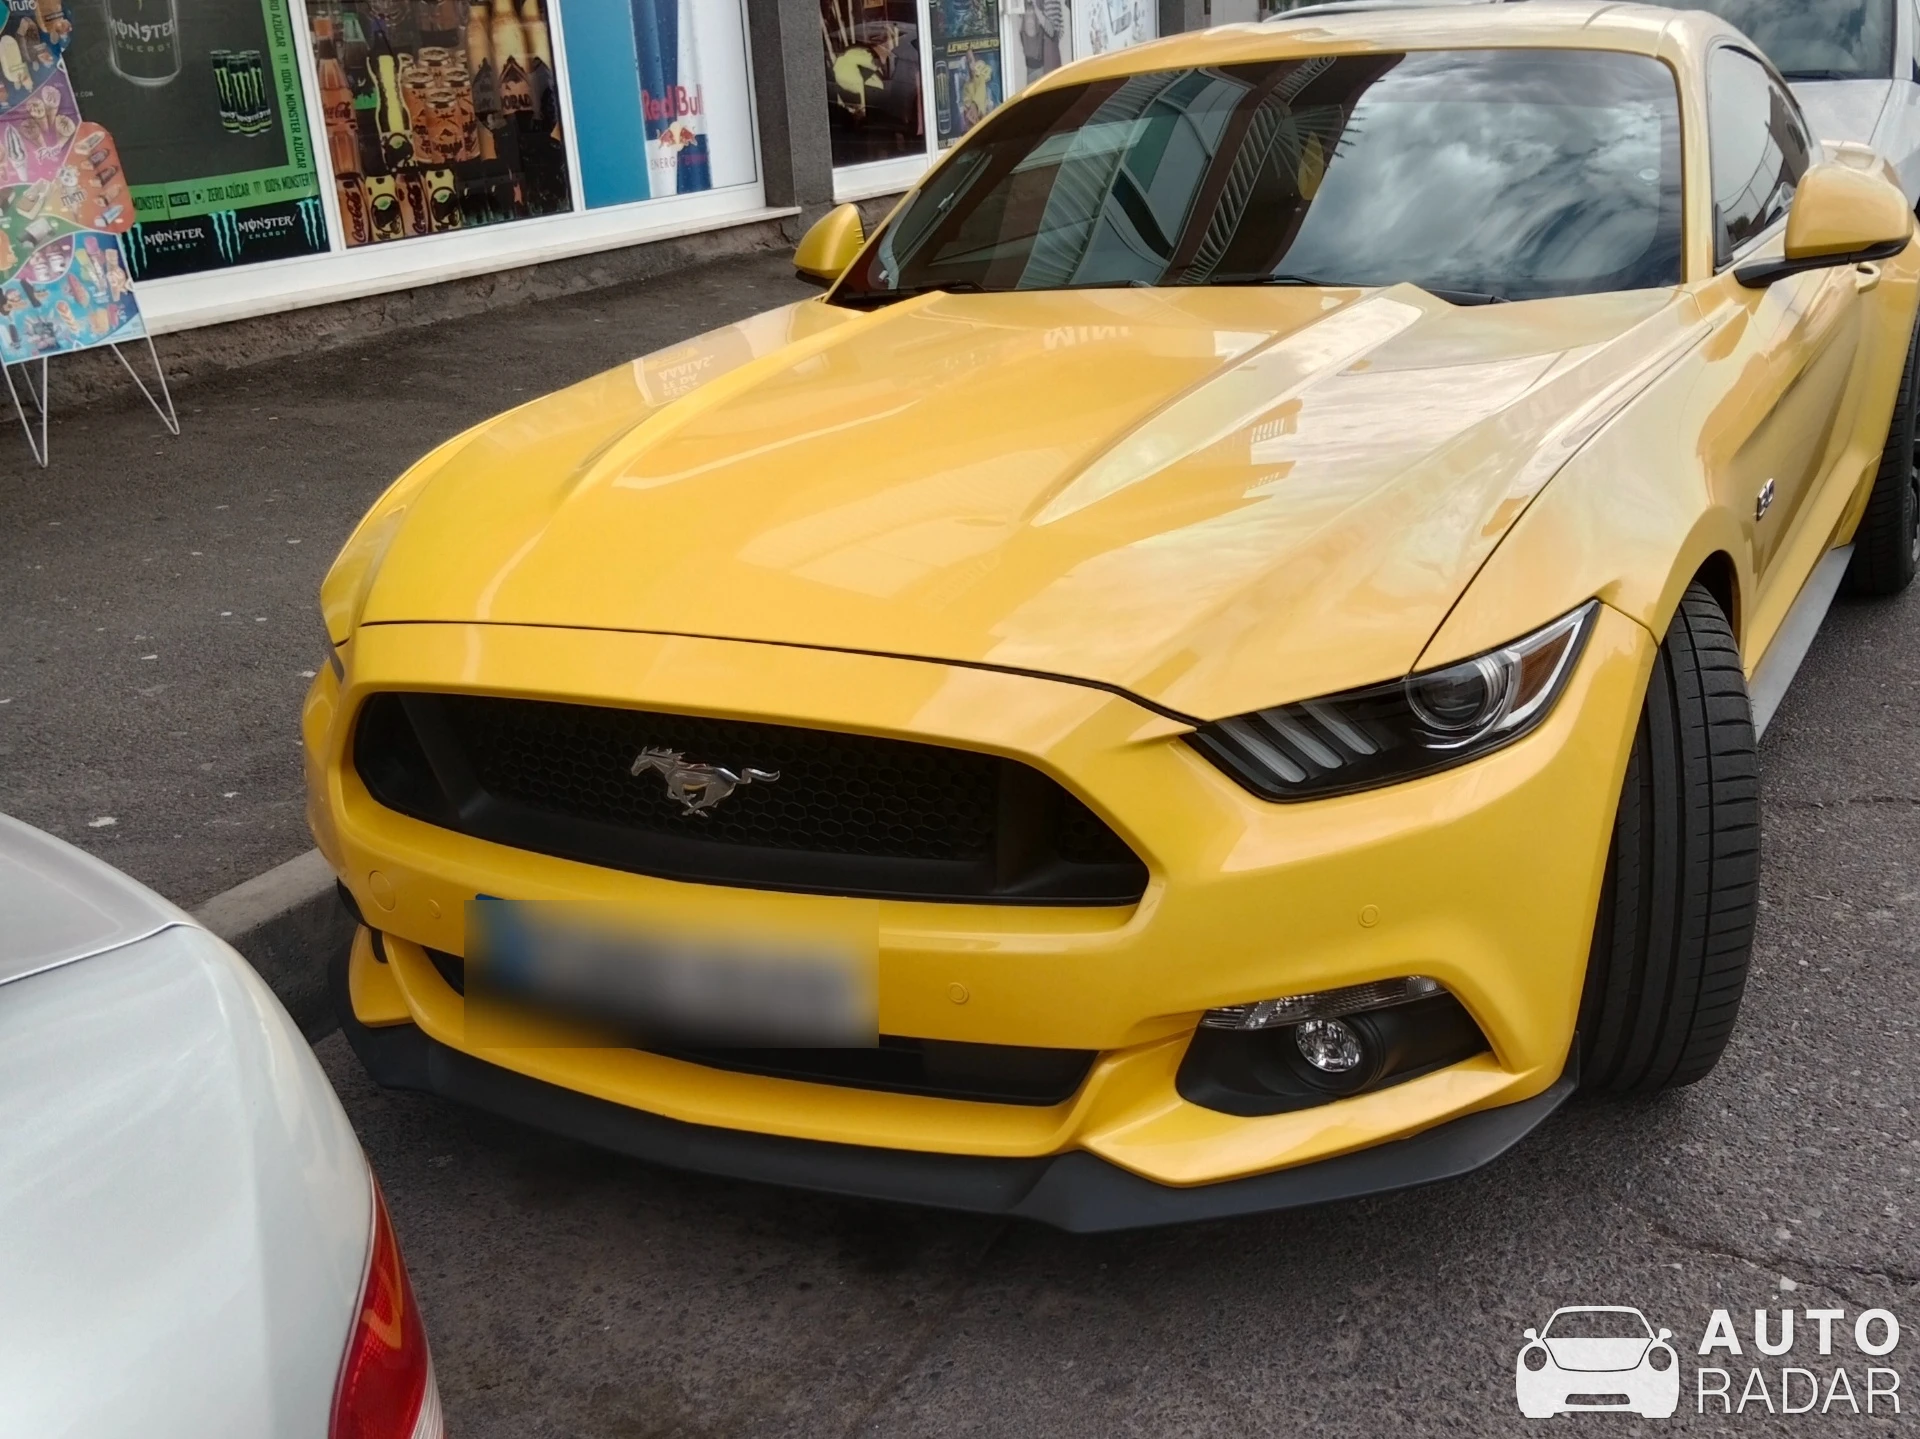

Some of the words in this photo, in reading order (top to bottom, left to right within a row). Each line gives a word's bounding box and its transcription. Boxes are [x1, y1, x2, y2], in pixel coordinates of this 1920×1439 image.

[947, 42, 970, 53] LEWIS
[271, 13, 286, 47] AZÚCAR
[285, 93, 301, 133] MONSTER
[293, 135, 307, 168] AZÚCAR
[642, 86, 675, 121] Red
[207, 187, 224, 202] ZERO
[237, 215, 293, 233] MONSTER
[143, 227, 205, 246] MONSTER
[248, 230, 287, 240] ENERGY
[156, 242, 198, 253] ENERGY
